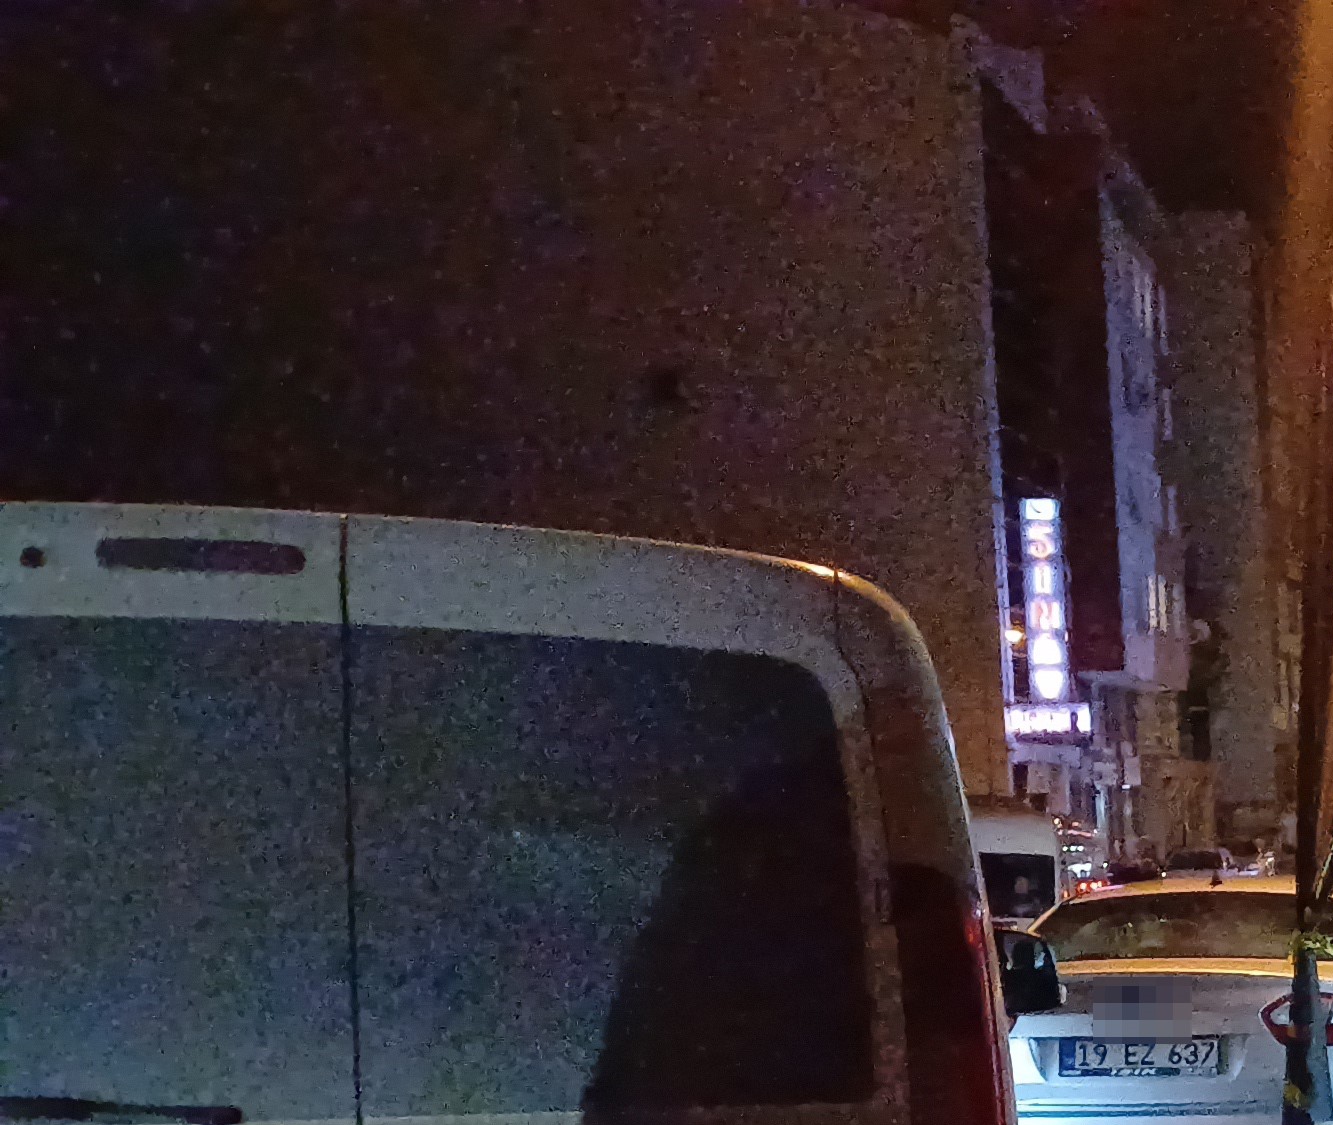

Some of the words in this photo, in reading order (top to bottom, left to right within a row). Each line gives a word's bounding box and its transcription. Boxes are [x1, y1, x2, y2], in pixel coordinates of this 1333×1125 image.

[1077, 1043, 1108, 1067] 19
[1123, 1043, 1156, 1066] EZ
[1167, 1041, 1216, 1066] 637
